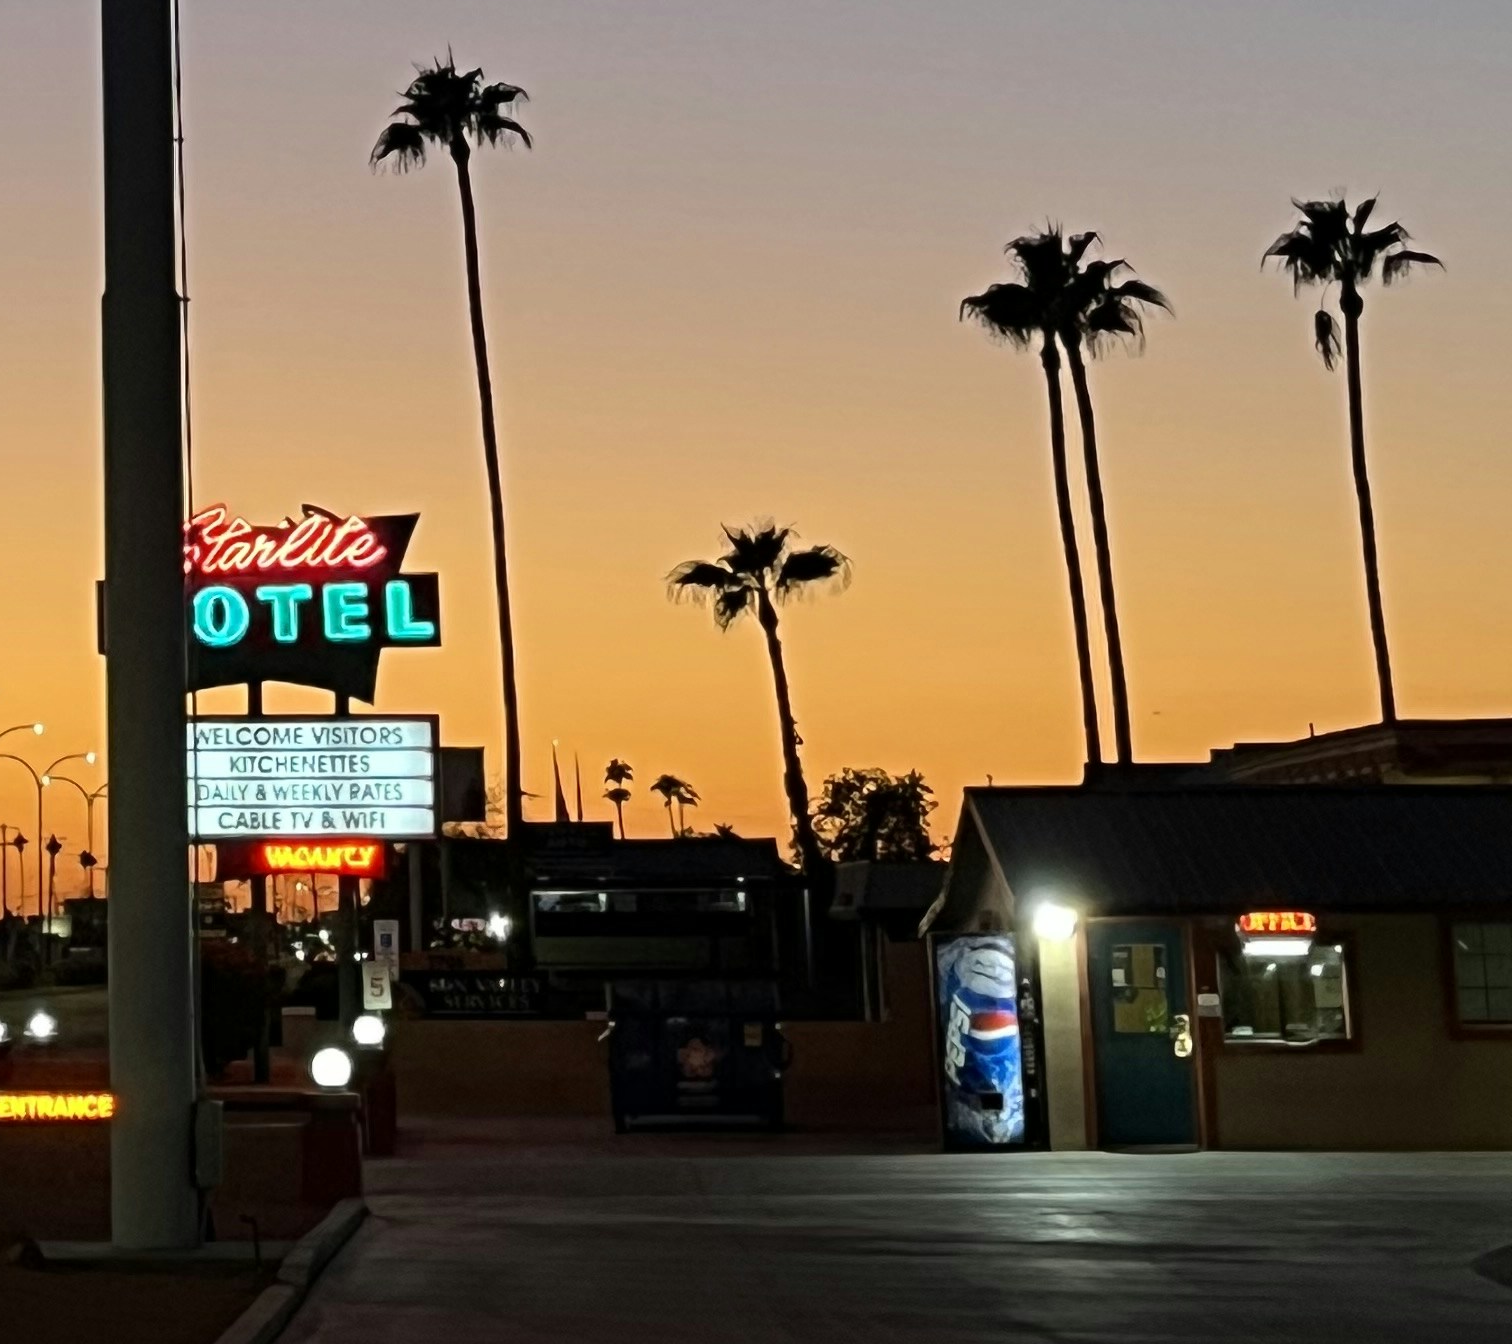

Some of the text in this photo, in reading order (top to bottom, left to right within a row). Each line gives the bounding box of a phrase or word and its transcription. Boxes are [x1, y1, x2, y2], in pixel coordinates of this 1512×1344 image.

[192, 580, 435, 647] OTEL
[196, 726, 403, 745] WELCOME VISITORS
[230, 755, 370, 773] KITCHENETTES
[198, 783, 403, 801] DAILY & WEEKLY RATES
[218, 812, 282, 830] CABLE
[292, 812, 313, 829] TV
[321, 811, 337, 829] &
